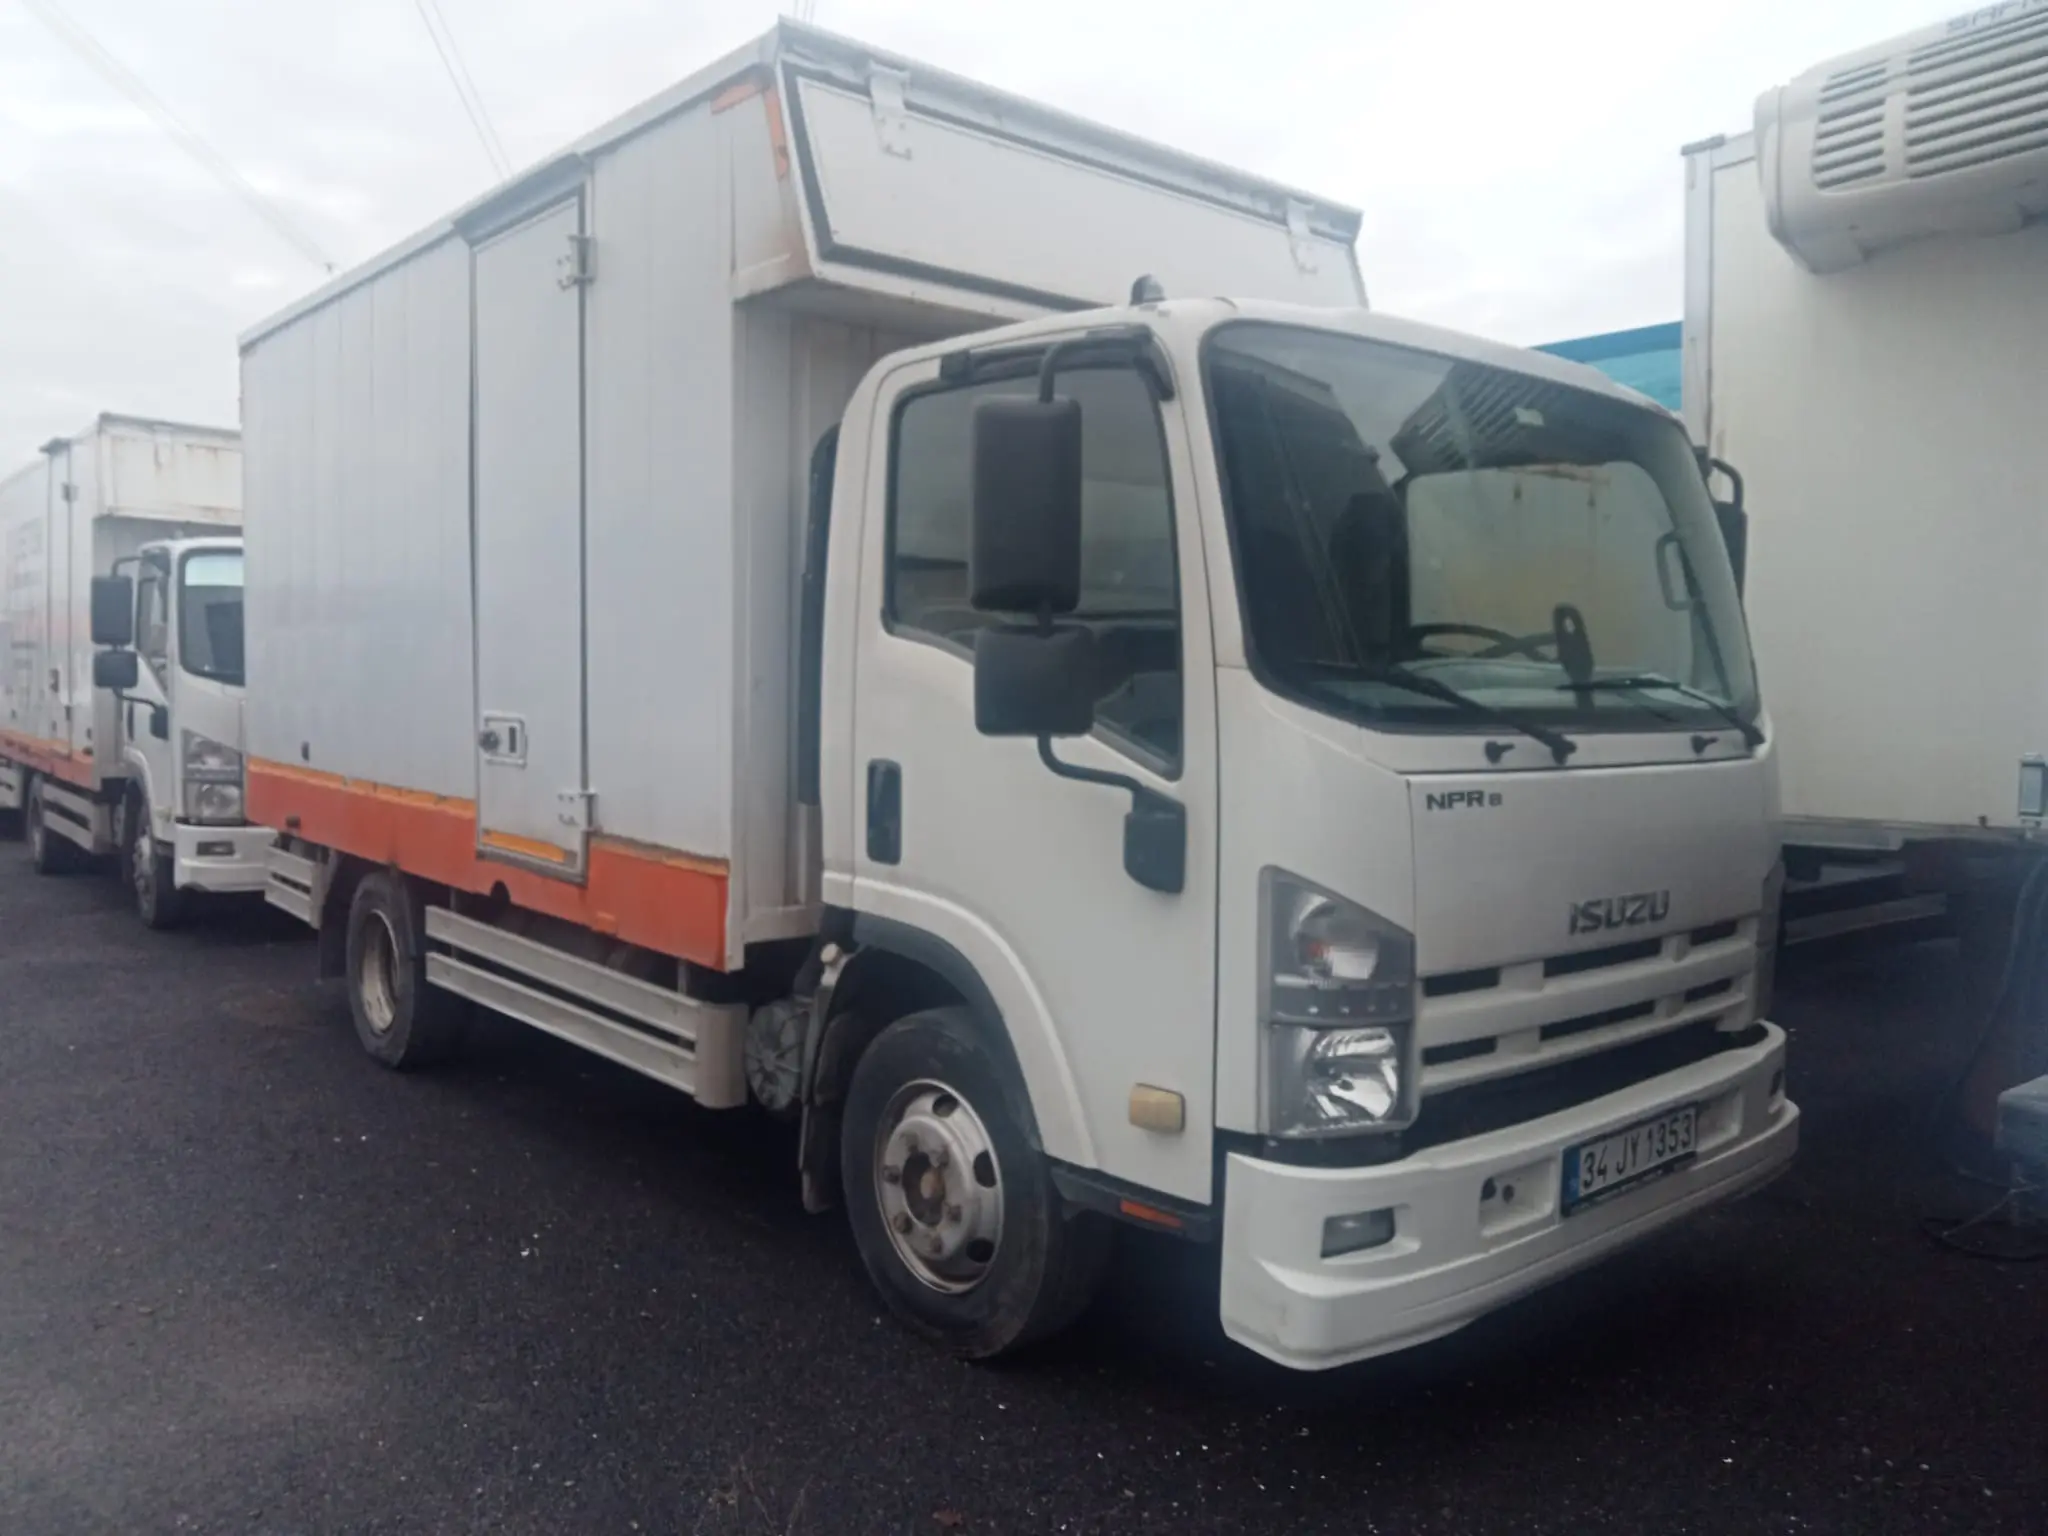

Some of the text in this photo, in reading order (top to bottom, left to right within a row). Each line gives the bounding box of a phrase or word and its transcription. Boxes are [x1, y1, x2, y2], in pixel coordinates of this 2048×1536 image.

[1426, 790, 1484, 811] NPR
[1568, 890, 1670, 936] ISUZU
[1583, 1145, 1607, 1189] 34
[1616, 1132, 1640, 1176] JY
[1647, 1113, 1692, 1163] 1353
